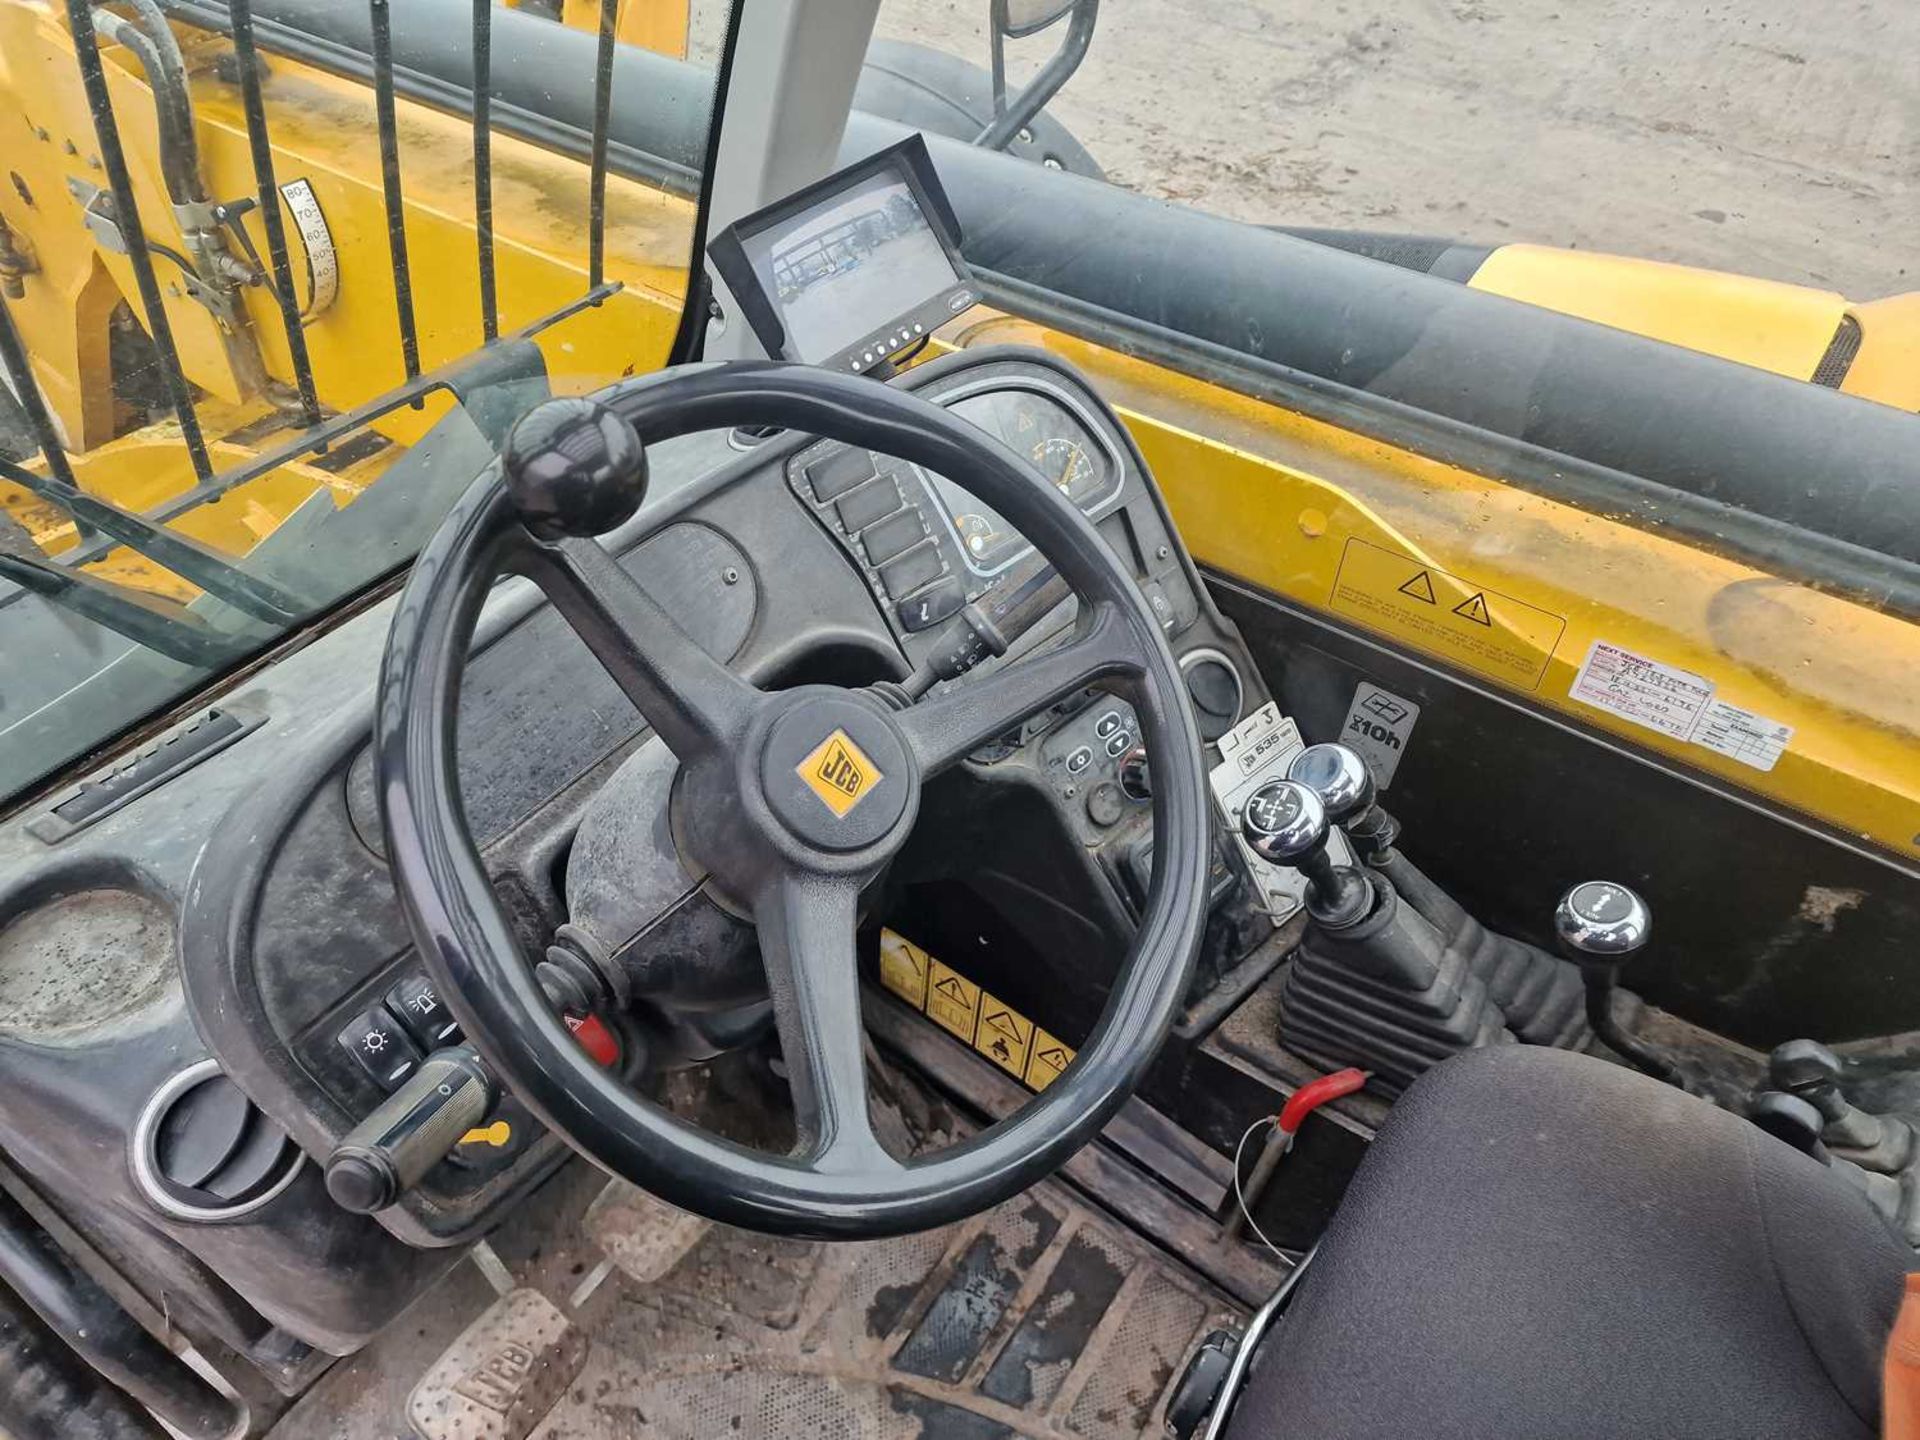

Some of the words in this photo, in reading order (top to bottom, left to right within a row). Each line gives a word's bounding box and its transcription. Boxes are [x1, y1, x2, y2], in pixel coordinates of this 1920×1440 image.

[286, 186, 303, 199] 80
[297, 207, 312, 220] 70
[306, 229, 321, 242] 60
[312, 249, 326, 261] 50
[317, 267, 330, 278] 40
[1597, 644, 1618, 656] NEXT
[1620, 652, 1654, 669] SERVICE
[1255, 732, 1281, 756] 535
[823, 750, 859, 793] JCB
